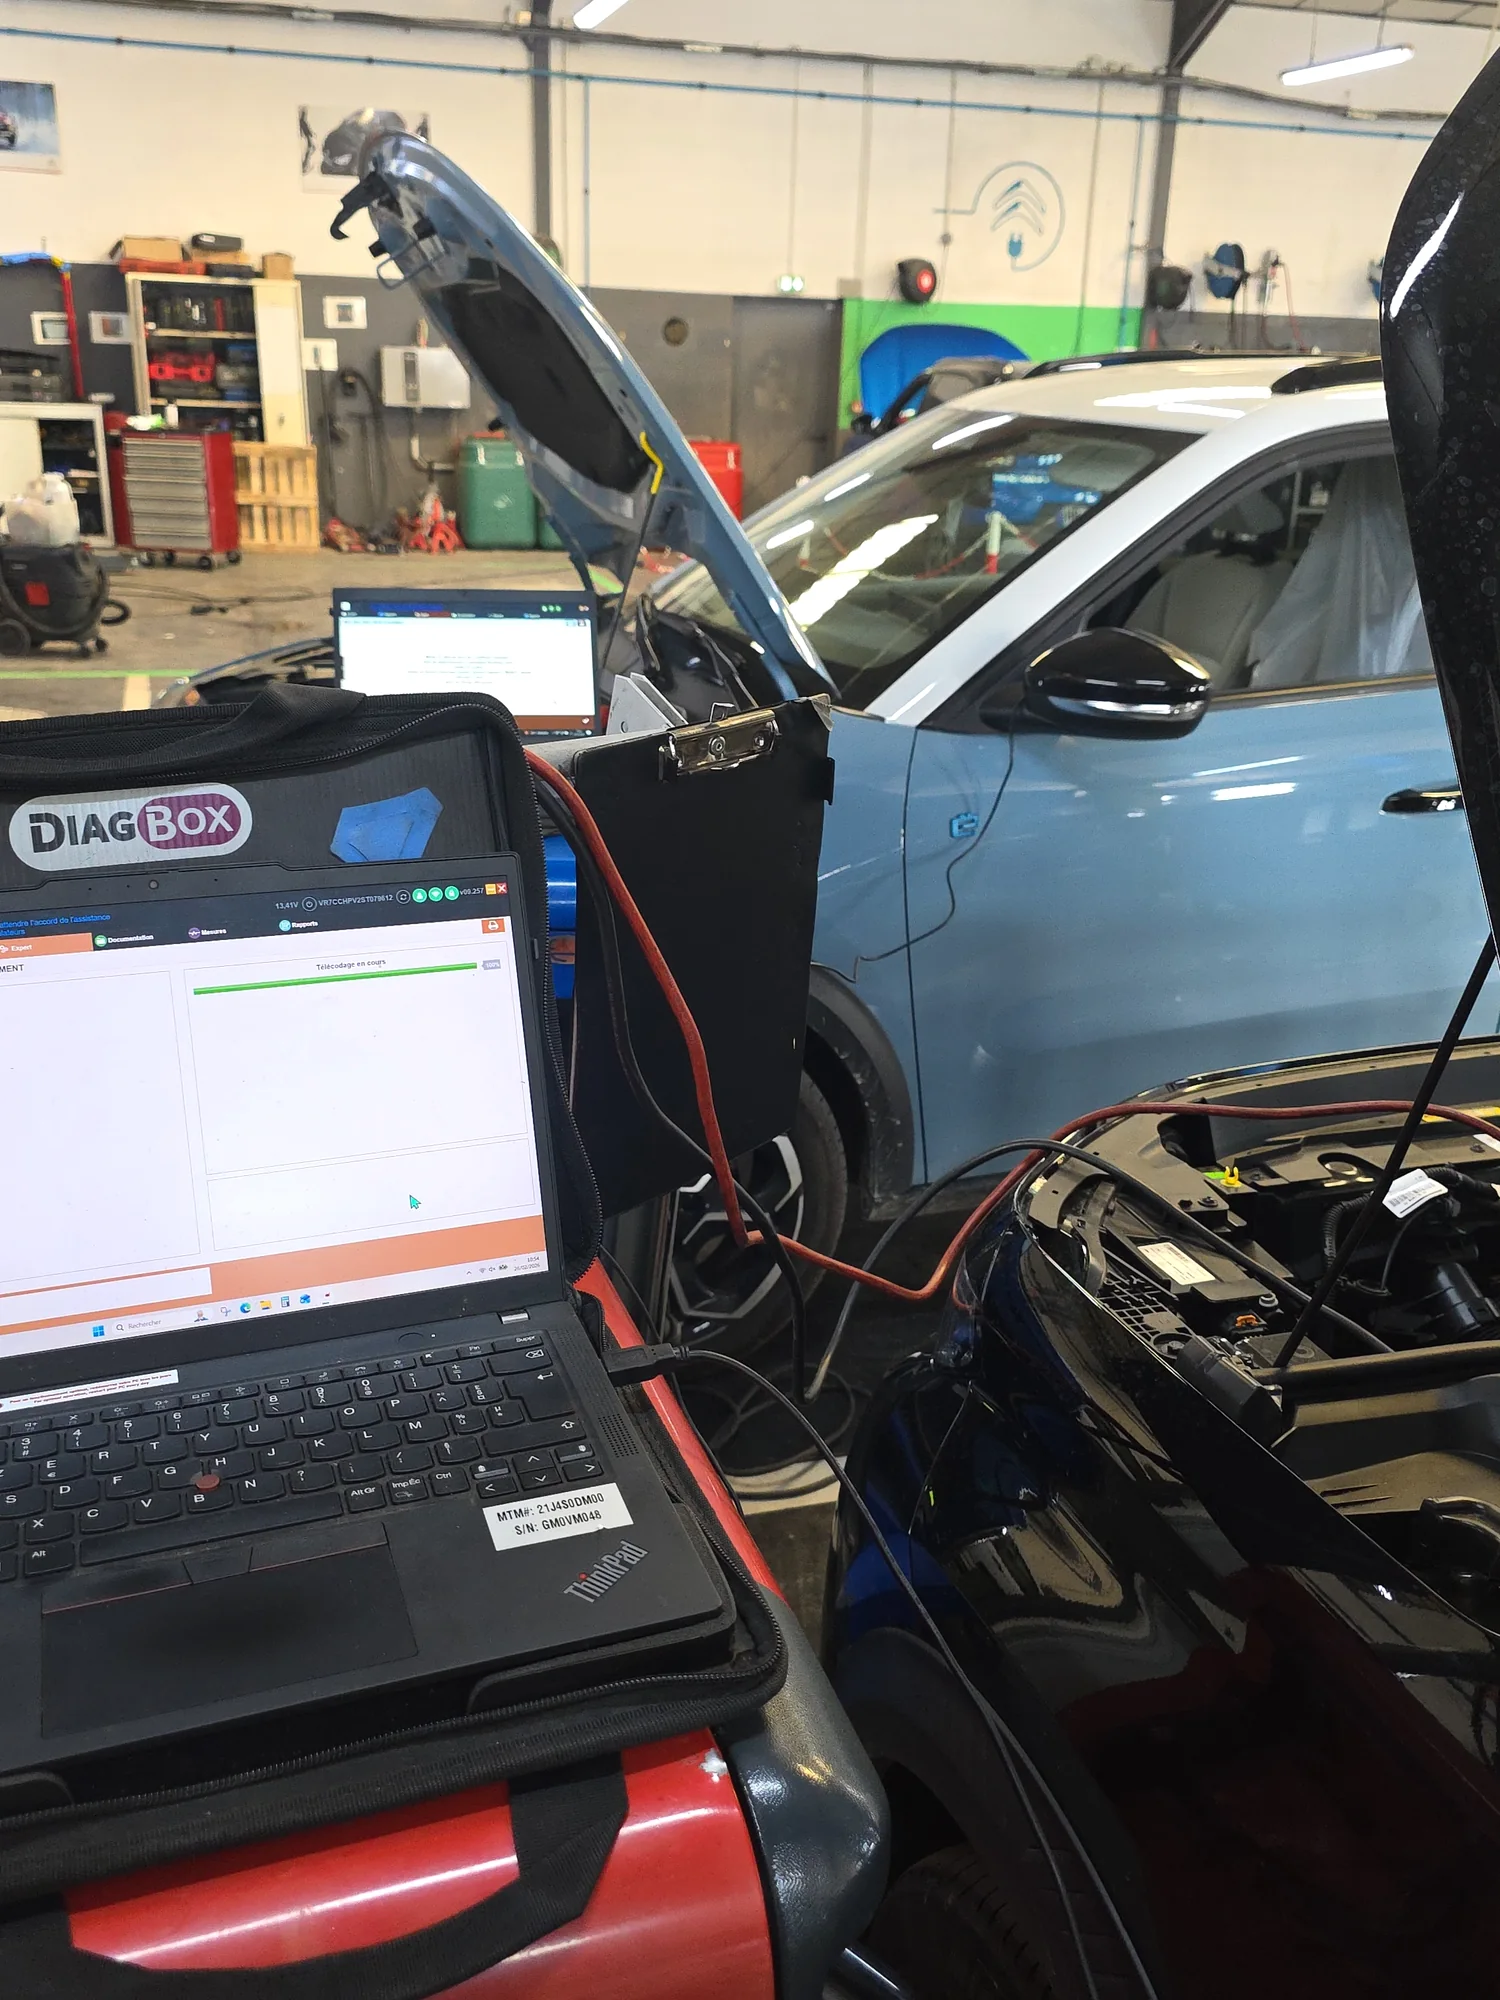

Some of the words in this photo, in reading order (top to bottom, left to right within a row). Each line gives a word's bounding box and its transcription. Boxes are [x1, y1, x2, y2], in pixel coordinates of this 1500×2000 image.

[275, 901, 299, 910] 13,41V
[59, 916, 69, 924] de
[291, 920, 319, 929] Rapports
[107, 933, 154, 944] Documentation
[11, 944, 33, 953] Expert
[315, 961, 356, 971] Télécodage
[128, 1318, 162, 1330] Rechercher
[515, 1335, 536, 1343] Suppr
[221, 1403, 230, 1411] 7
[390, 1399, 400, 1407] P
[123, 1420, 133, 1428] 5
[248, 1424, 259, 1432] U
[408, 1421, 422, 1430] M
[72, 1428, 82, 1436] 4
[363, 1431, 373, 1439] L
[21, 1437, 31, 1446] 3
[199, 1433, 210, 1441] Y
[149, 1441, 160, 1450] T
[313, 1438, 326, 1447] K
[98, 1451, 109, 1459] R
[267, 1447, 276, 1456] J
[46, 1460, 57, 1469] E
[215, 1457, 227, 1466] H
[164, 1466, 177, 1475] G
[112, 1475, 123, 1485] F
[435, 1471, 452, 1480] Ctrl
[245, 1479, 257, 1488] N
[59, 1485, 71, 1494] D
[350, 1487, 364, 1497] Alt
[364, 1486, 376, 1494] Gr
[5, 1494, 17, 1504] S
[140, 1498, 152, 1508] V
[193, 1494, 205, 1503] B
[86, 1508, 99, 1518] C
[496, 1507, 535, 1522] MTM#:
[32, 1518, 45, 1529] X
[514, 1521, 540, 1536] S/N:
[31, 1550, 47, 1559] Alt
[563, 1539, 649, 1603] ThinkPad
